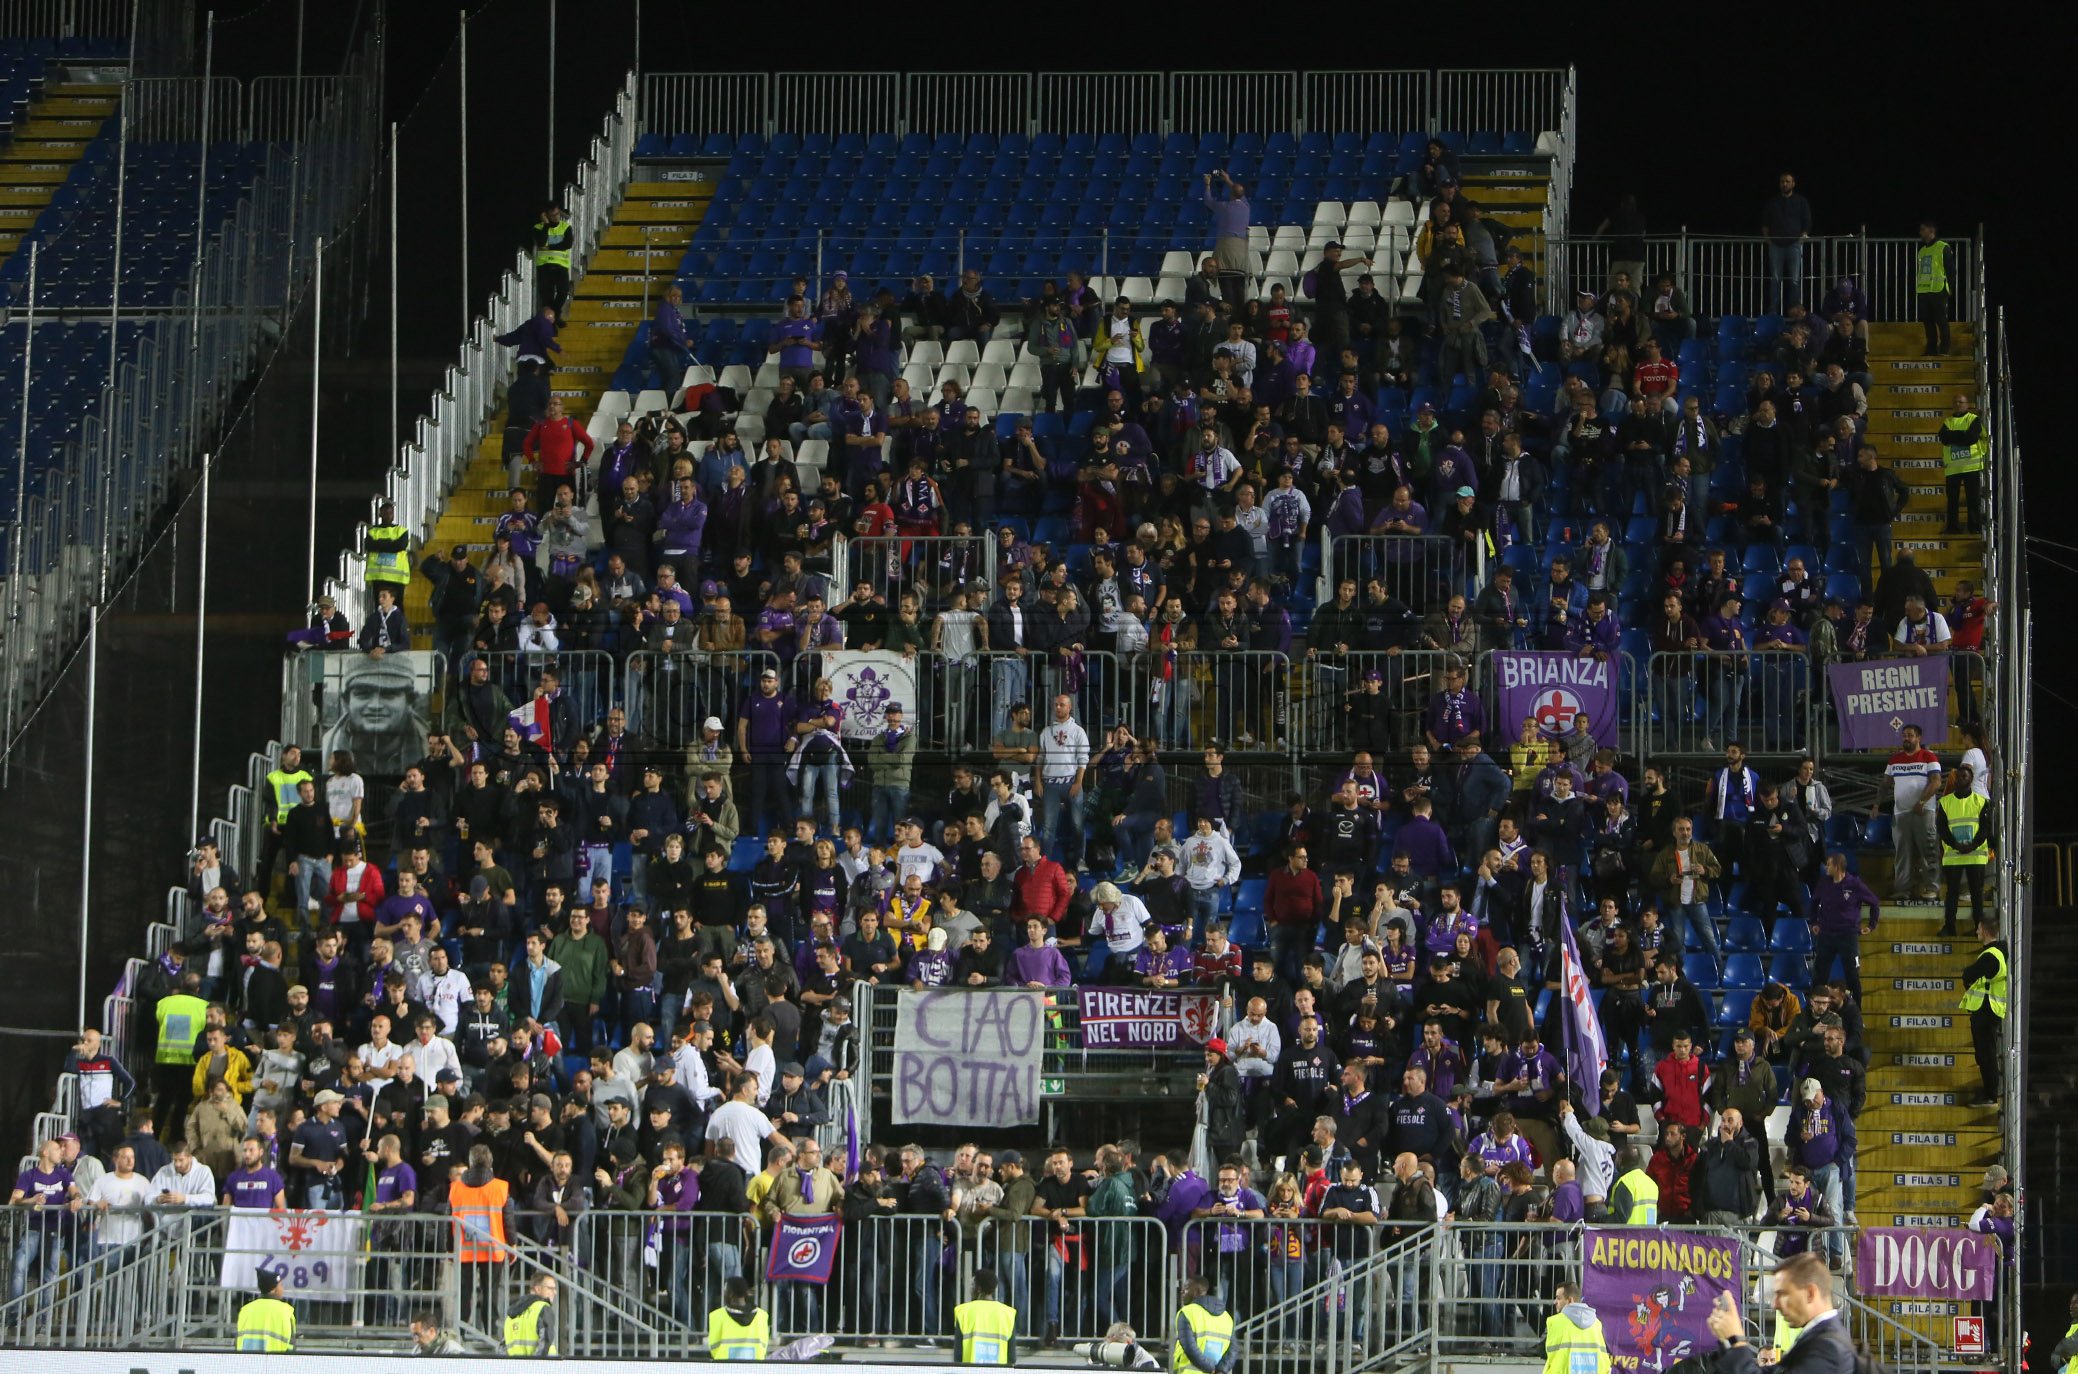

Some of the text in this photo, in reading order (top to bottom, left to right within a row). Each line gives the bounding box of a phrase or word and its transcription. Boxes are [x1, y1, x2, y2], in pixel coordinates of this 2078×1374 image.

[1502, 656, 1608, 690] BRIANZA
[1861, 664, 1920, 691] REGNI
[1847, 686, 1939, 715] PRESENTE
[1906, 945, 1928, 953] FILA
[1931, 945, 1939, 953] 11
[1084, 991, 1177, 1017] FIRENZE
[915, 991, 1037, 1058] CIAO
[1087, 1022, 1177, 1044] NEL NORD
[1907, 1018, 1928, 1026] FILA
[1294, 1067, 1324, 1080] FIESOLE
[1908, 1096, 1929, 1104] FILA
[1396, 1115, 1426, 1125] FIESOLE
[783, 1225, 834, 1236] FIORENTINA
[1592, 1236, 1733, 1280] AFICIONADOS
[1874, 1235, 1977, 1291] DOCG
[1908, 1305, 1931, 1313] FILA
